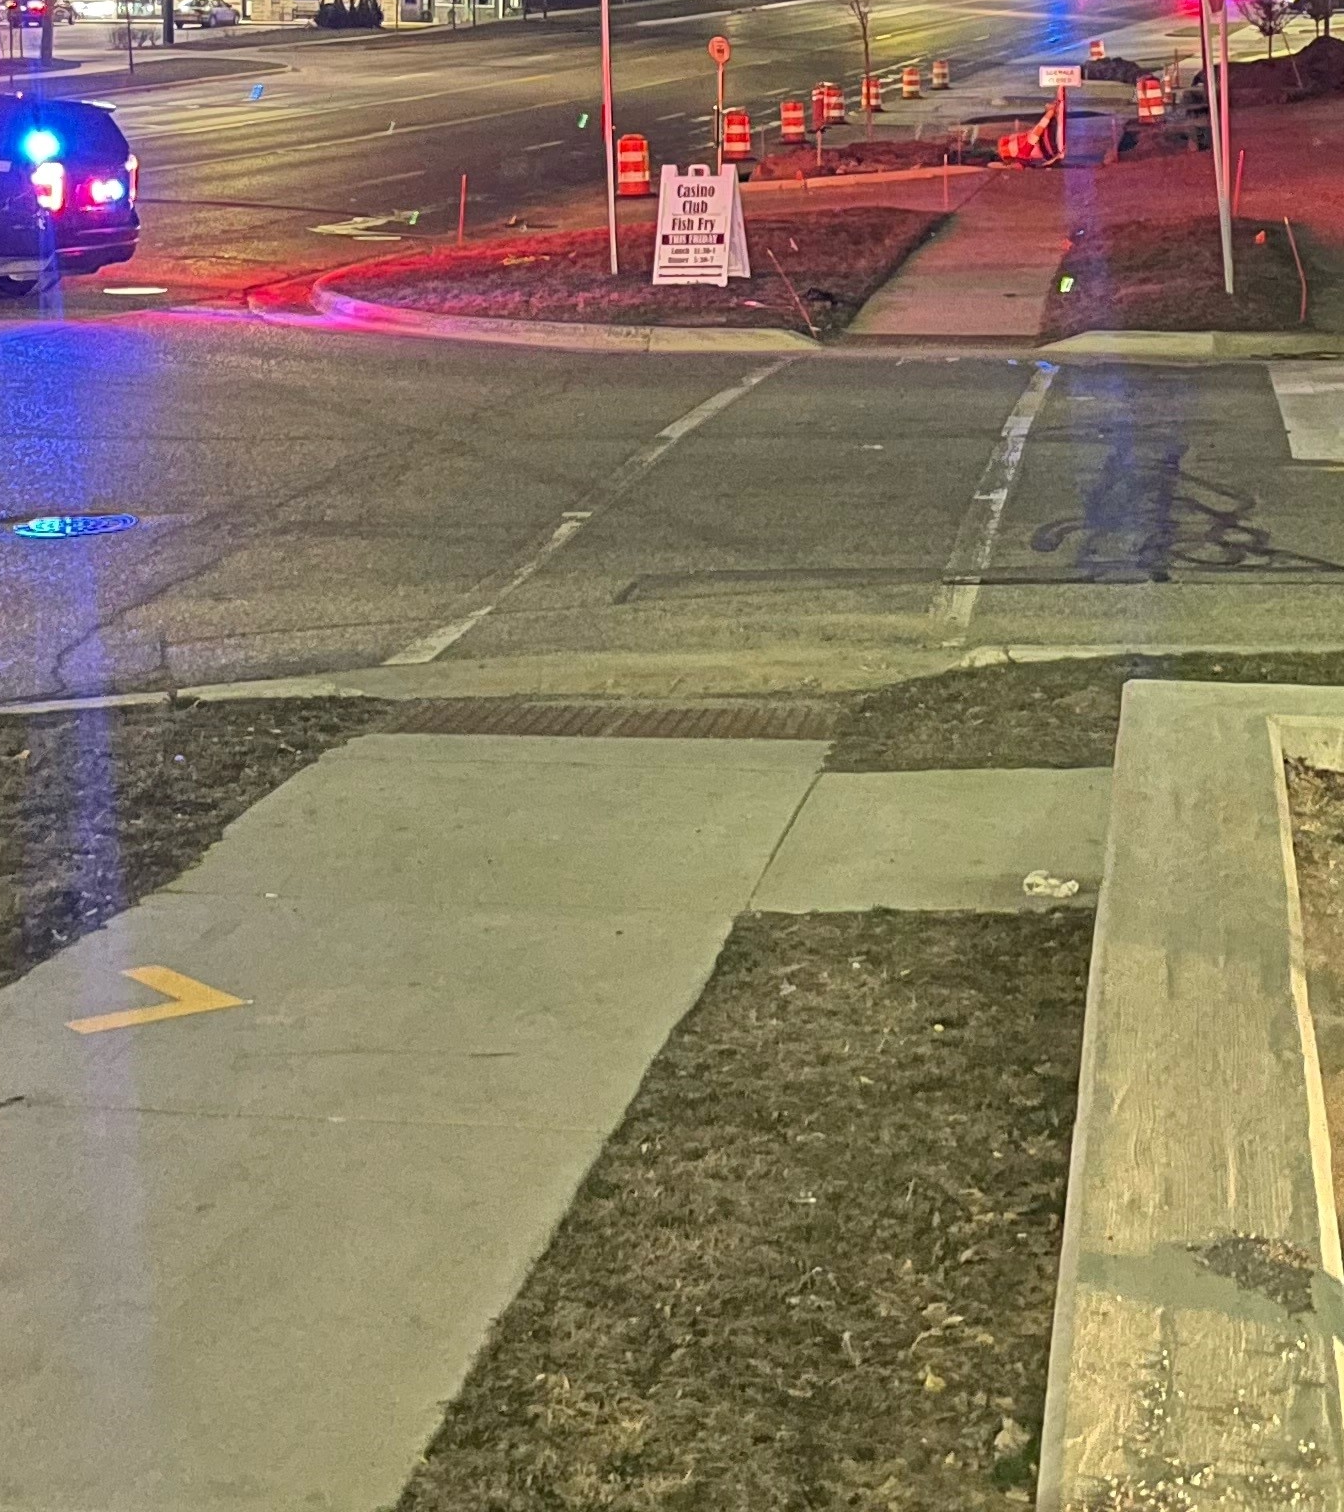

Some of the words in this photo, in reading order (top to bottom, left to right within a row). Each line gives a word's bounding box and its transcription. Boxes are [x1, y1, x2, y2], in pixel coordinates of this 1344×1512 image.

[677, 184, 715, 198] Casino
[682, 200, 708, 214] Club
[671, 217, 694, 230] Fish
[697, 217, 716, 232] Fry
